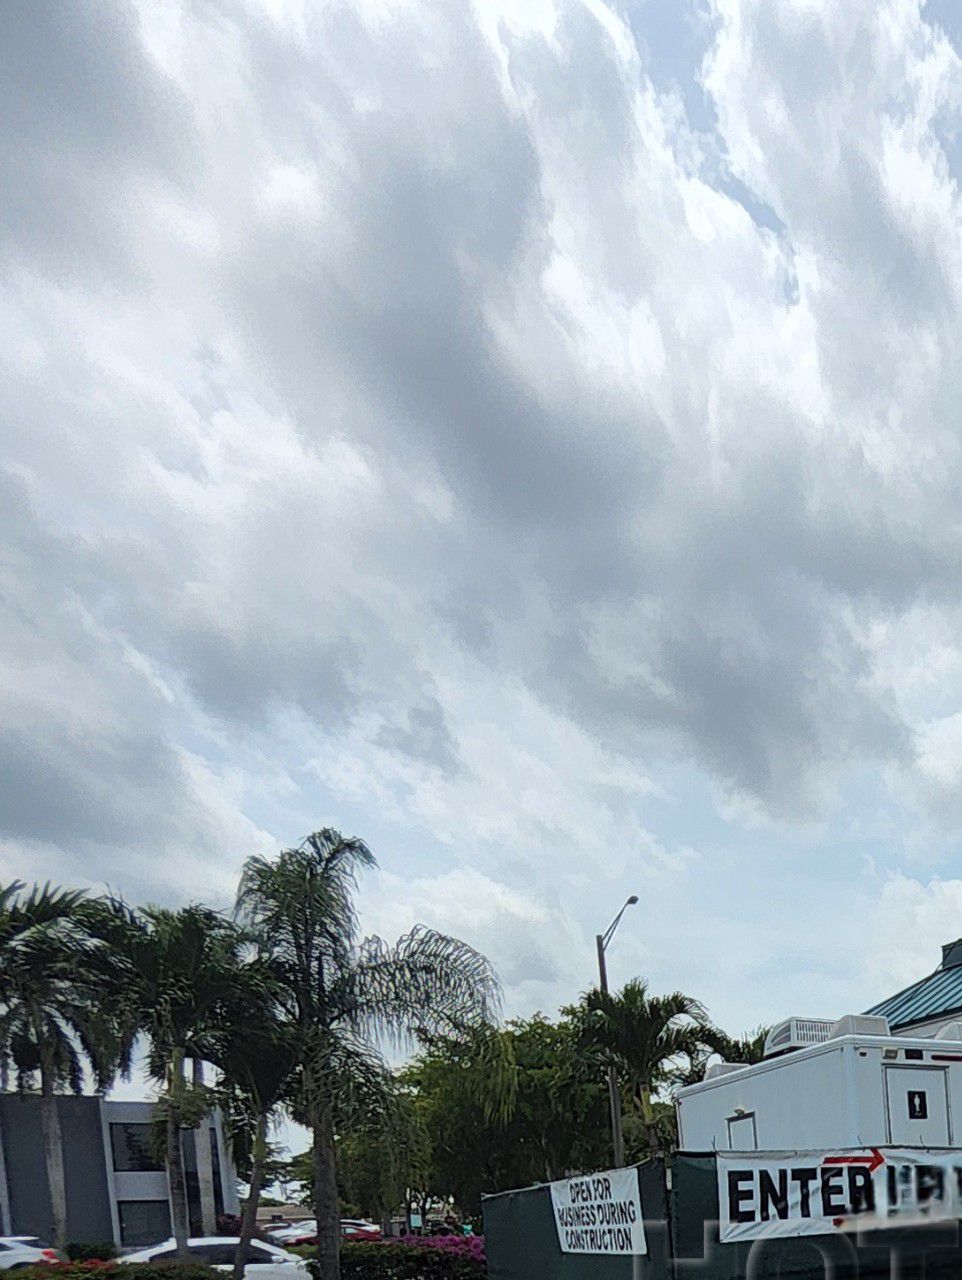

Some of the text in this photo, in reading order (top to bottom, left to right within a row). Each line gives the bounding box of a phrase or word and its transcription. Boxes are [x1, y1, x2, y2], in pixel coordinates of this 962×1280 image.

[568, 1178, 612, 1203] OPEN FOR
[727, 1165, 876, 1223] ENTER
[557, 1200, 637, 1228] BUSINESS DURING
[565, 1227, 633, 1251] CONSTRUCTION
